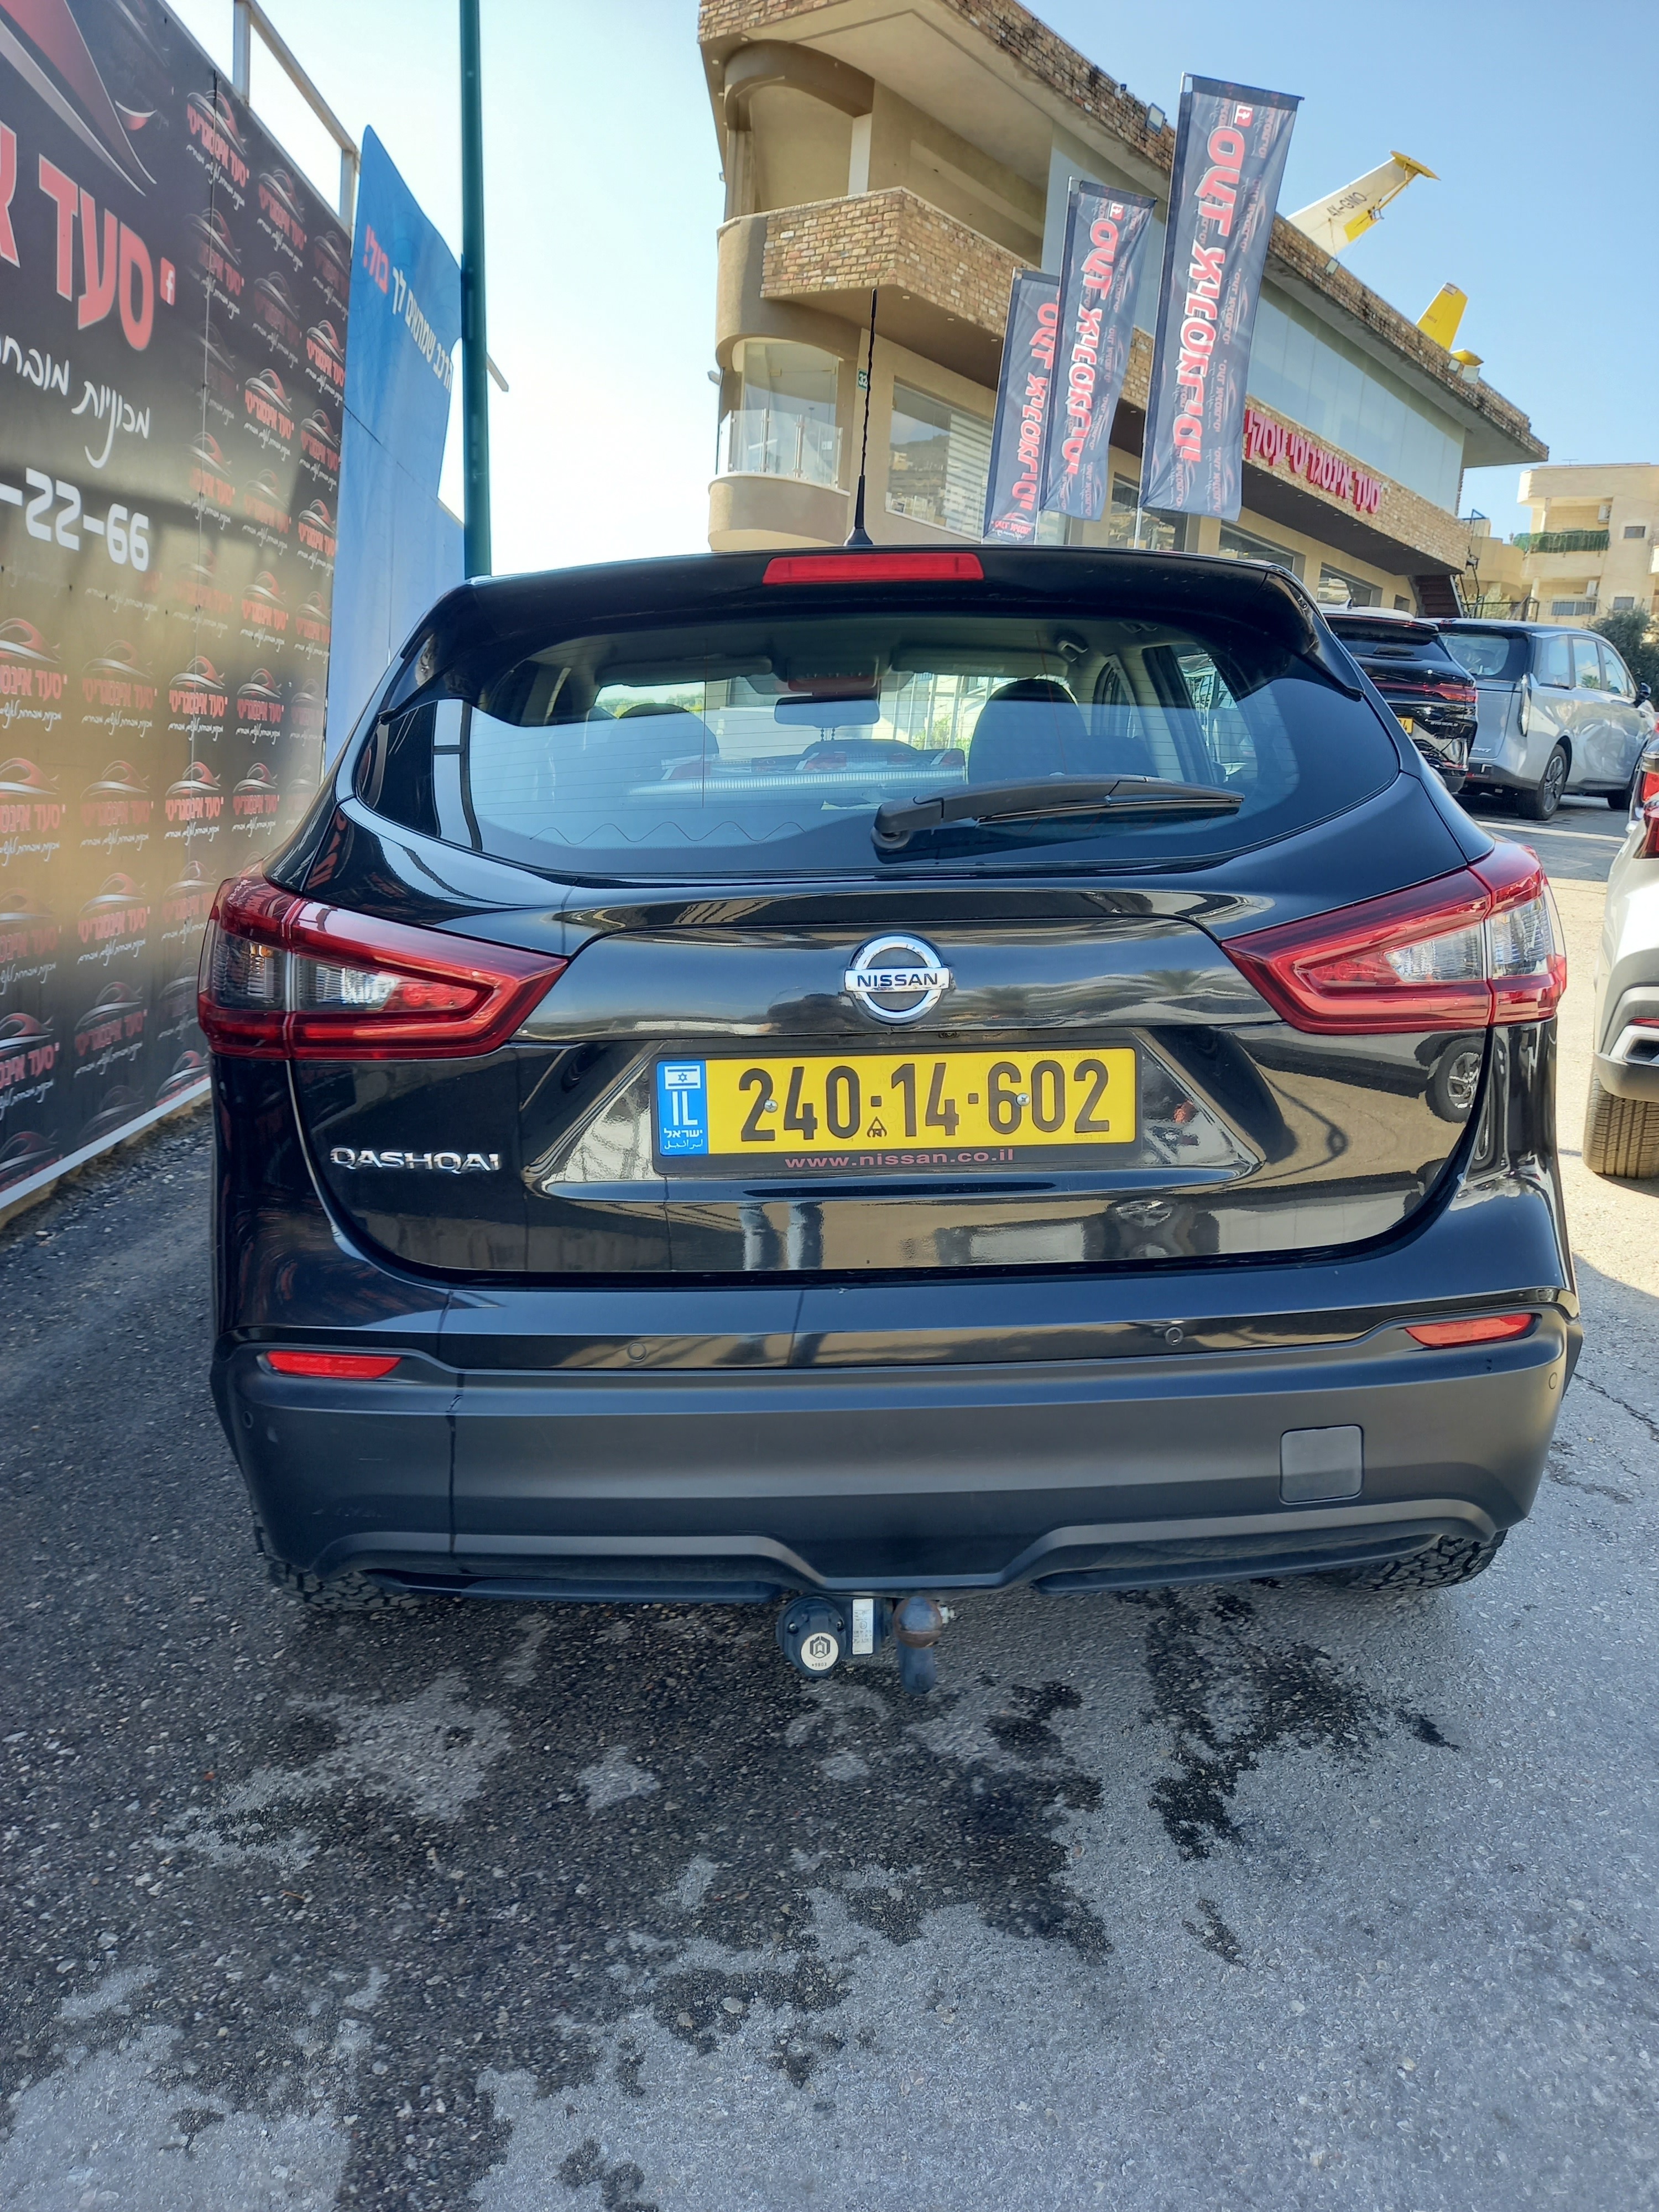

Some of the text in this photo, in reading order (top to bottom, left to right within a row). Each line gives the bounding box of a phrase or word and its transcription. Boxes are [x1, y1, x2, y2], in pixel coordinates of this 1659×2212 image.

[39, 153, 154, 352] סעד
[392, 266, 406, 315] לך
[0, 336, 69, 395] מובח
[71, 381, 150, 468] מכוניות
[1353, 471, 1381, 514] סעד
[858, 973, 937, 987] NISSAN
[672, 1091, 698, 1126] IL
[664, 1128, 703, 1138] ישראל
[330, 1147, 500, 1174] QASHQAI
[785, 1149, 1013, 1168] www.nissan.co.il
